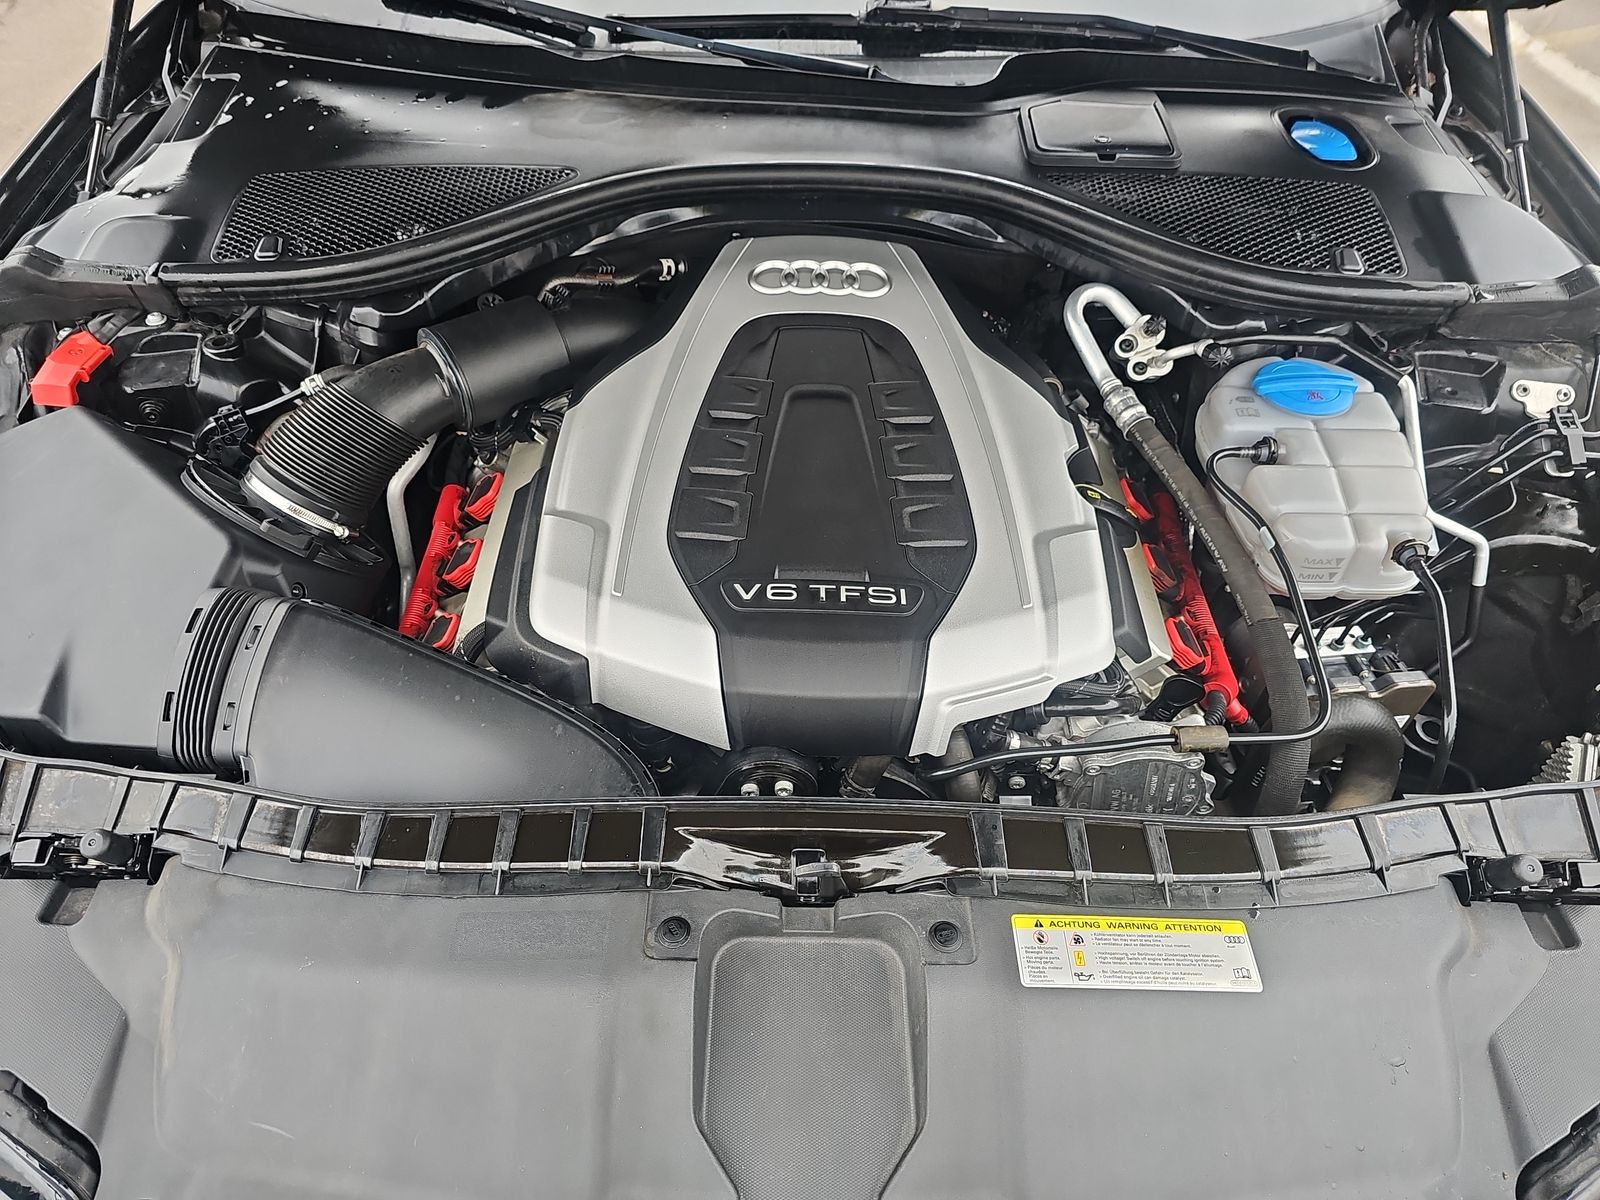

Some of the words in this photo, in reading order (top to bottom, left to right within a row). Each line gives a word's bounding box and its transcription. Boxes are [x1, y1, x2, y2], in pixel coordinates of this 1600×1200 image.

[733, 583, 798, 601] V6
[809, 584, 907, 606] TFSI
[1049, 920, 1101, 929] ACHTUNG
[1107, 922, 1159, 931] WARNING
[1164, 923, 1222, 932] ATTENTION
